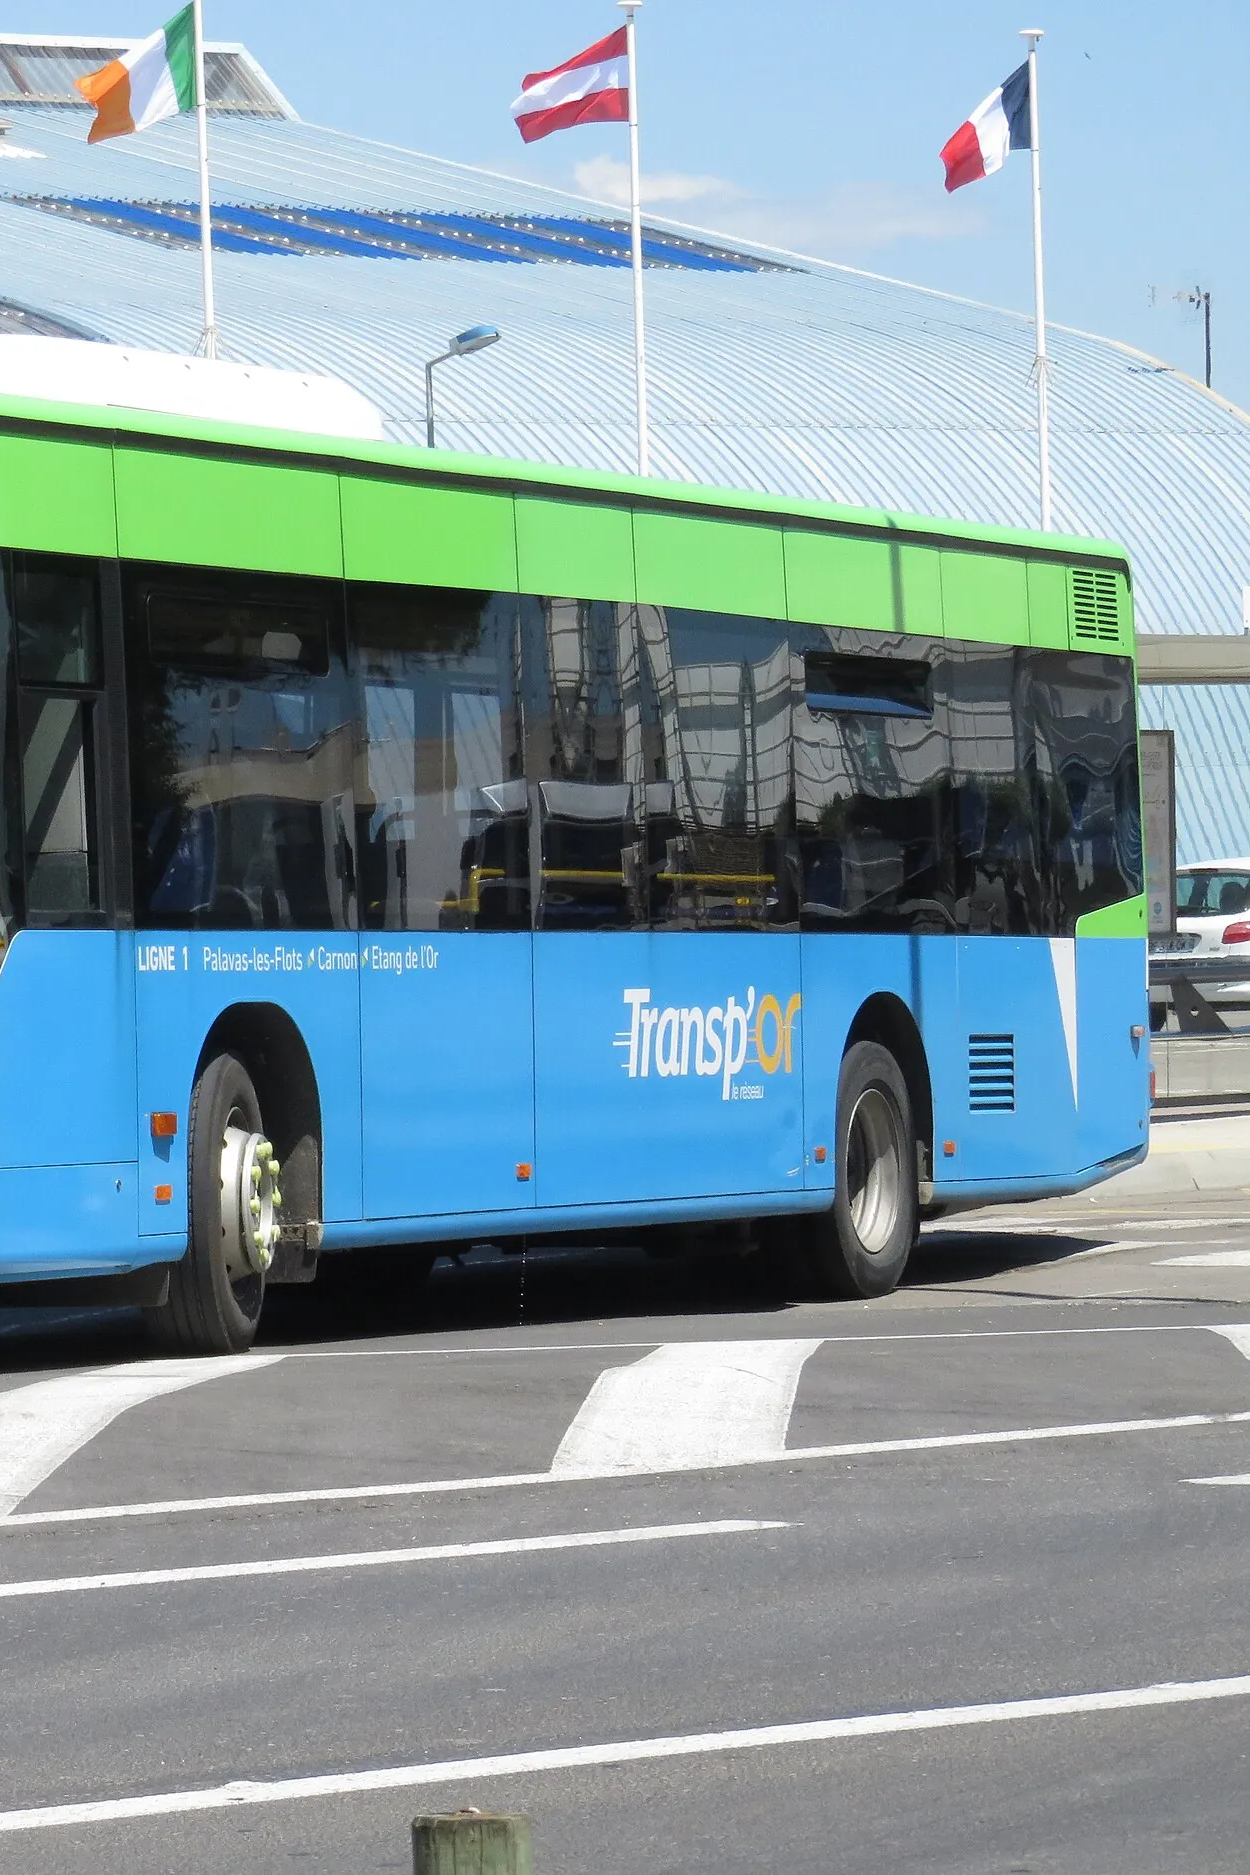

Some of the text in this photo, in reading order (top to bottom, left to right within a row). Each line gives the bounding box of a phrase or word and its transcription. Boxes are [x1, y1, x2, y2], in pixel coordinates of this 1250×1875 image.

[138, 945, 189, 971] LIGNE 1
[203, 944, 439, 975] Palavas-les-Flots Carnon Etang de l'Or
[731, 1082, 739, 1100] le
